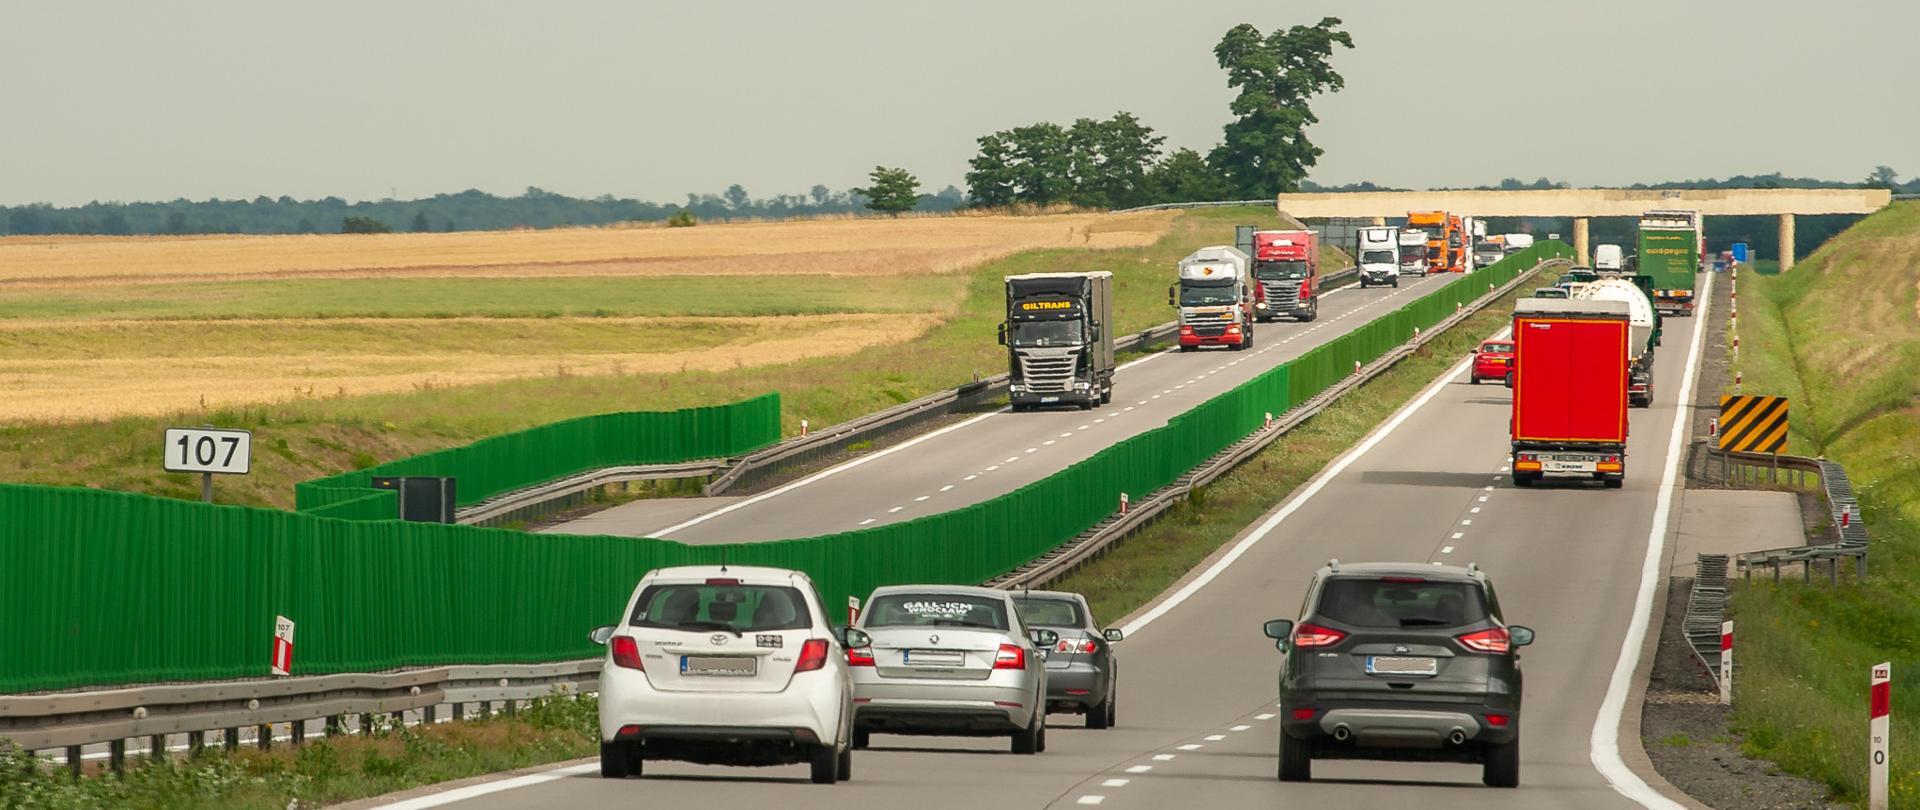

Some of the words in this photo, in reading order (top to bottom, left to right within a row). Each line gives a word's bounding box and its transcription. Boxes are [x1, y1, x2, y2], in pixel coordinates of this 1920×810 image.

[1022, 301, 1071, 310] GILTRANS
[177, 434, 240, 467] 107
[903, 601, 973, 611] GALL-ICM
[277, 624, 290, 632] 107
[1874, 750, 1885, 765] 0
